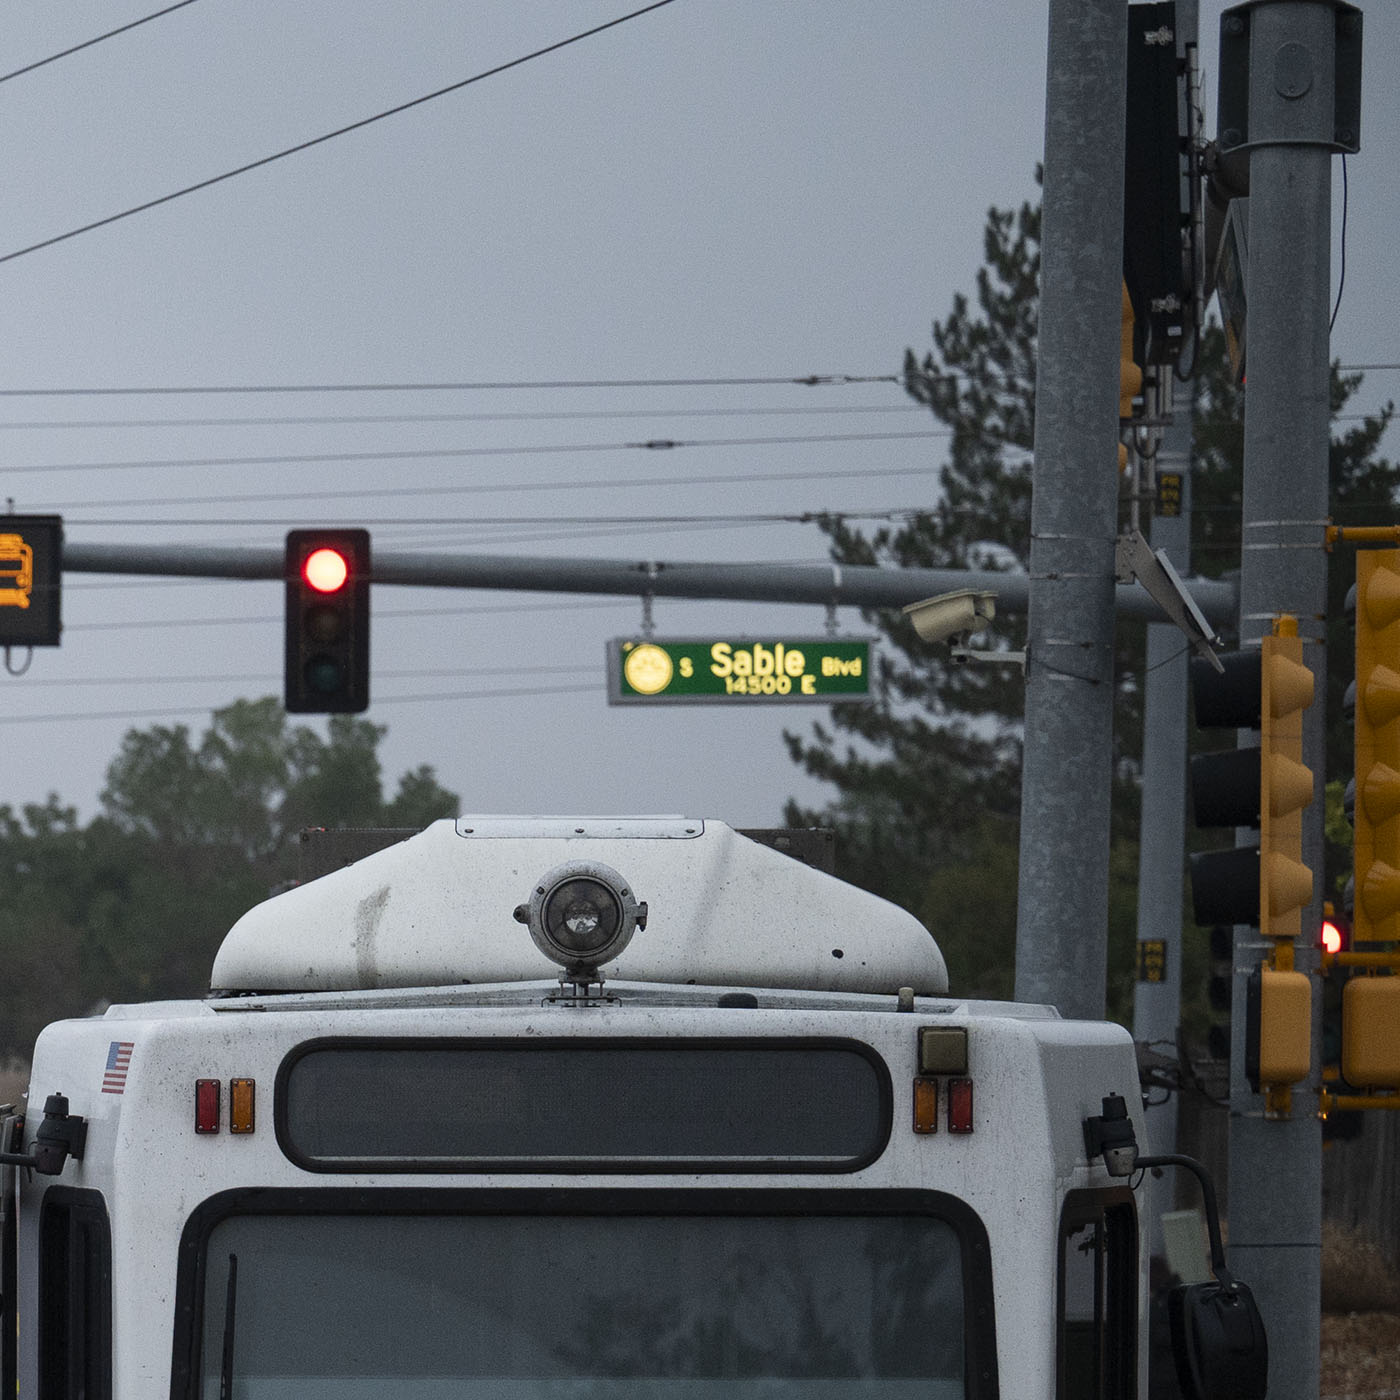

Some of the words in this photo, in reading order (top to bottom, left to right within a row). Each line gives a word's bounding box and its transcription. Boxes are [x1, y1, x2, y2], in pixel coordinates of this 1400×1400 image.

[679, 656, 694, 678] S
[710, 642, 806, 677] Sable
[821, 656, 863, 677] Blvd
[801, 674, 817, 695] E
